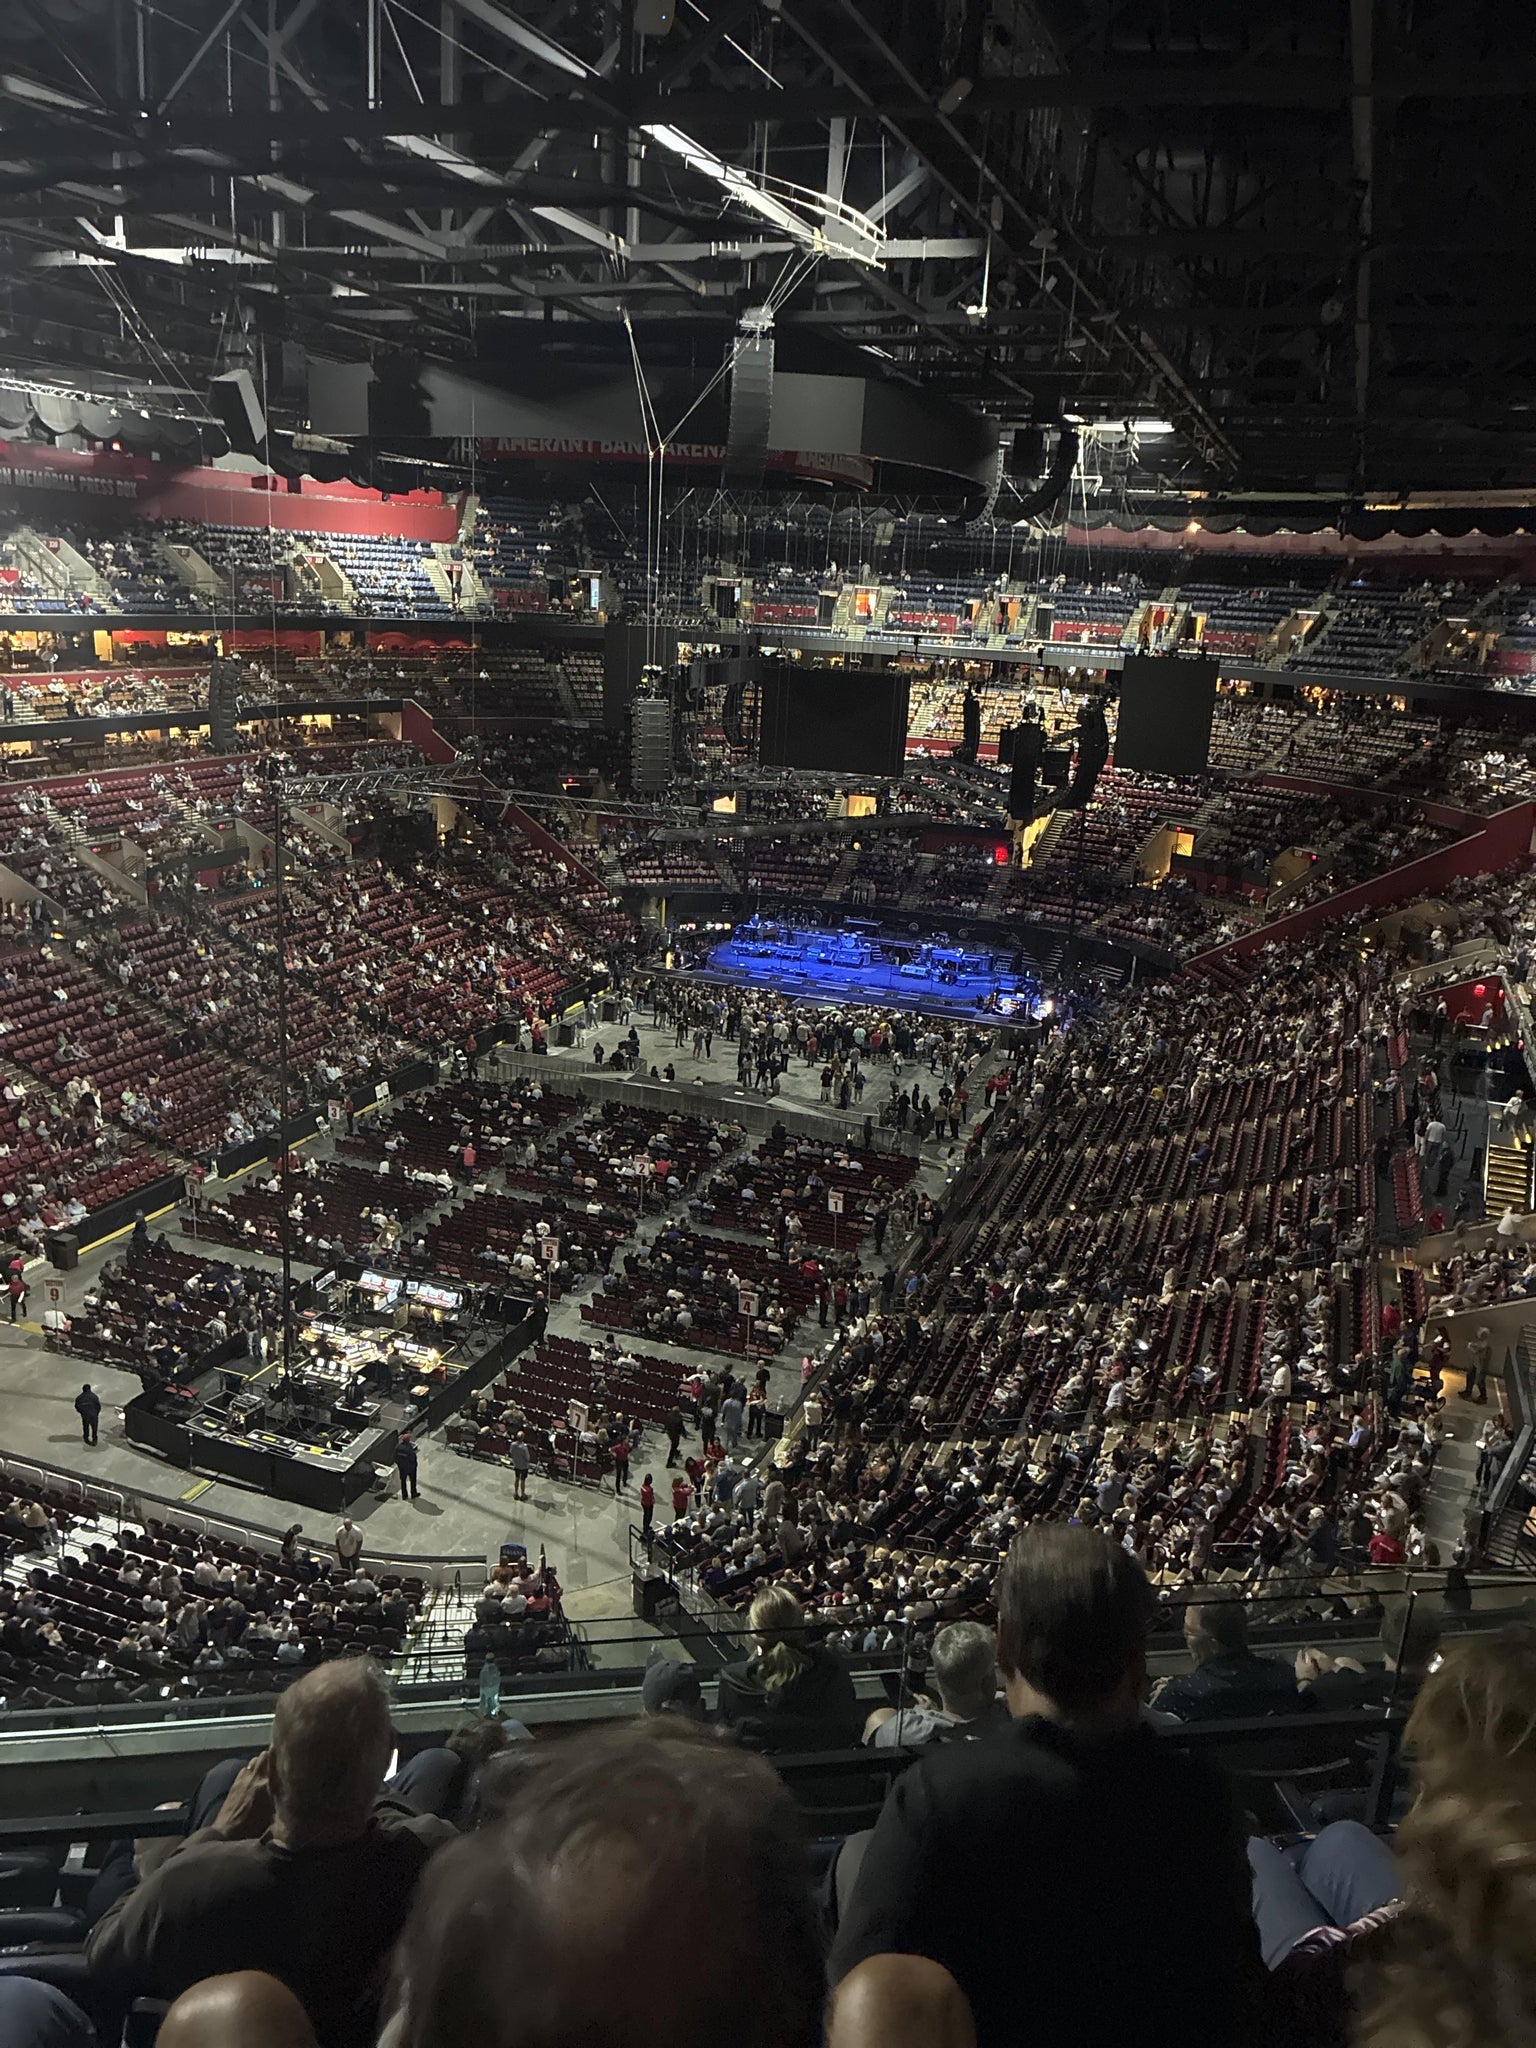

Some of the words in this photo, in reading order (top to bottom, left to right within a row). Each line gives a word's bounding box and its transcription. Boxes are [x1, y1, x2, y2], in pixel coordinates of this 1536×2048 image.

[497, 437, 594, 453] AMERANT
[14, 468, 77, 492] MEMORIAL
[79, 475, 114, 496] PRESS
[116, 479, 138, 498] BOX
[331, 1107, 337, 1118] 3
[639, 1163, 645, 1174] 2
[189, 1184, 195, 1196] 6
[833, 1200, 838, 1212] 1
[546, 1246, 553, 1258] 5
[50, 1288, 59, 1301] 9
[743, 1301, 751, 1313] 4
[575, 1413, 581, 1428] 7
